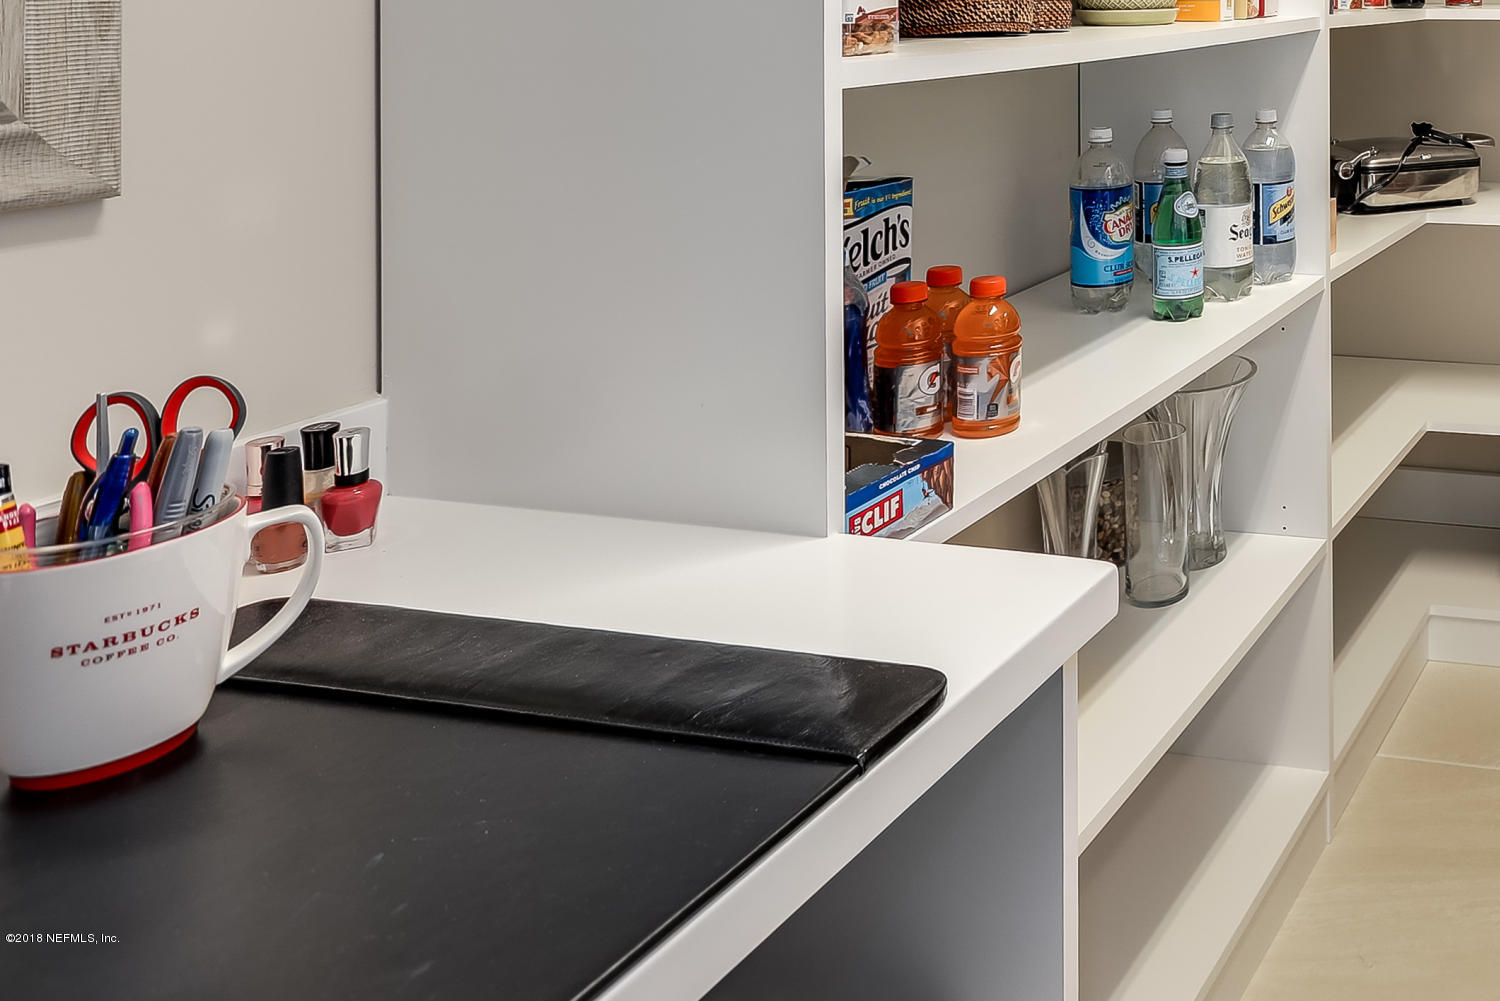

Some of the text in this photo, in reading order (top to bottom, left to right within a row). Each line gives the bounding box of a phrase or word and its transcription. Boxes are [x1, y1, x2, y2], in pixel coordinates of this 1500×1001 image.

[843, 213, 910, 273] elch's
[878, 470, 908, 490] CHOCOLATE
[861, 494, 900, 534] CLIF
[136, 602, 162, 615] 1971
[50, 607, 200, 659] STARBUCKS
[80, 633, 180, 668] COFFEE CO.
